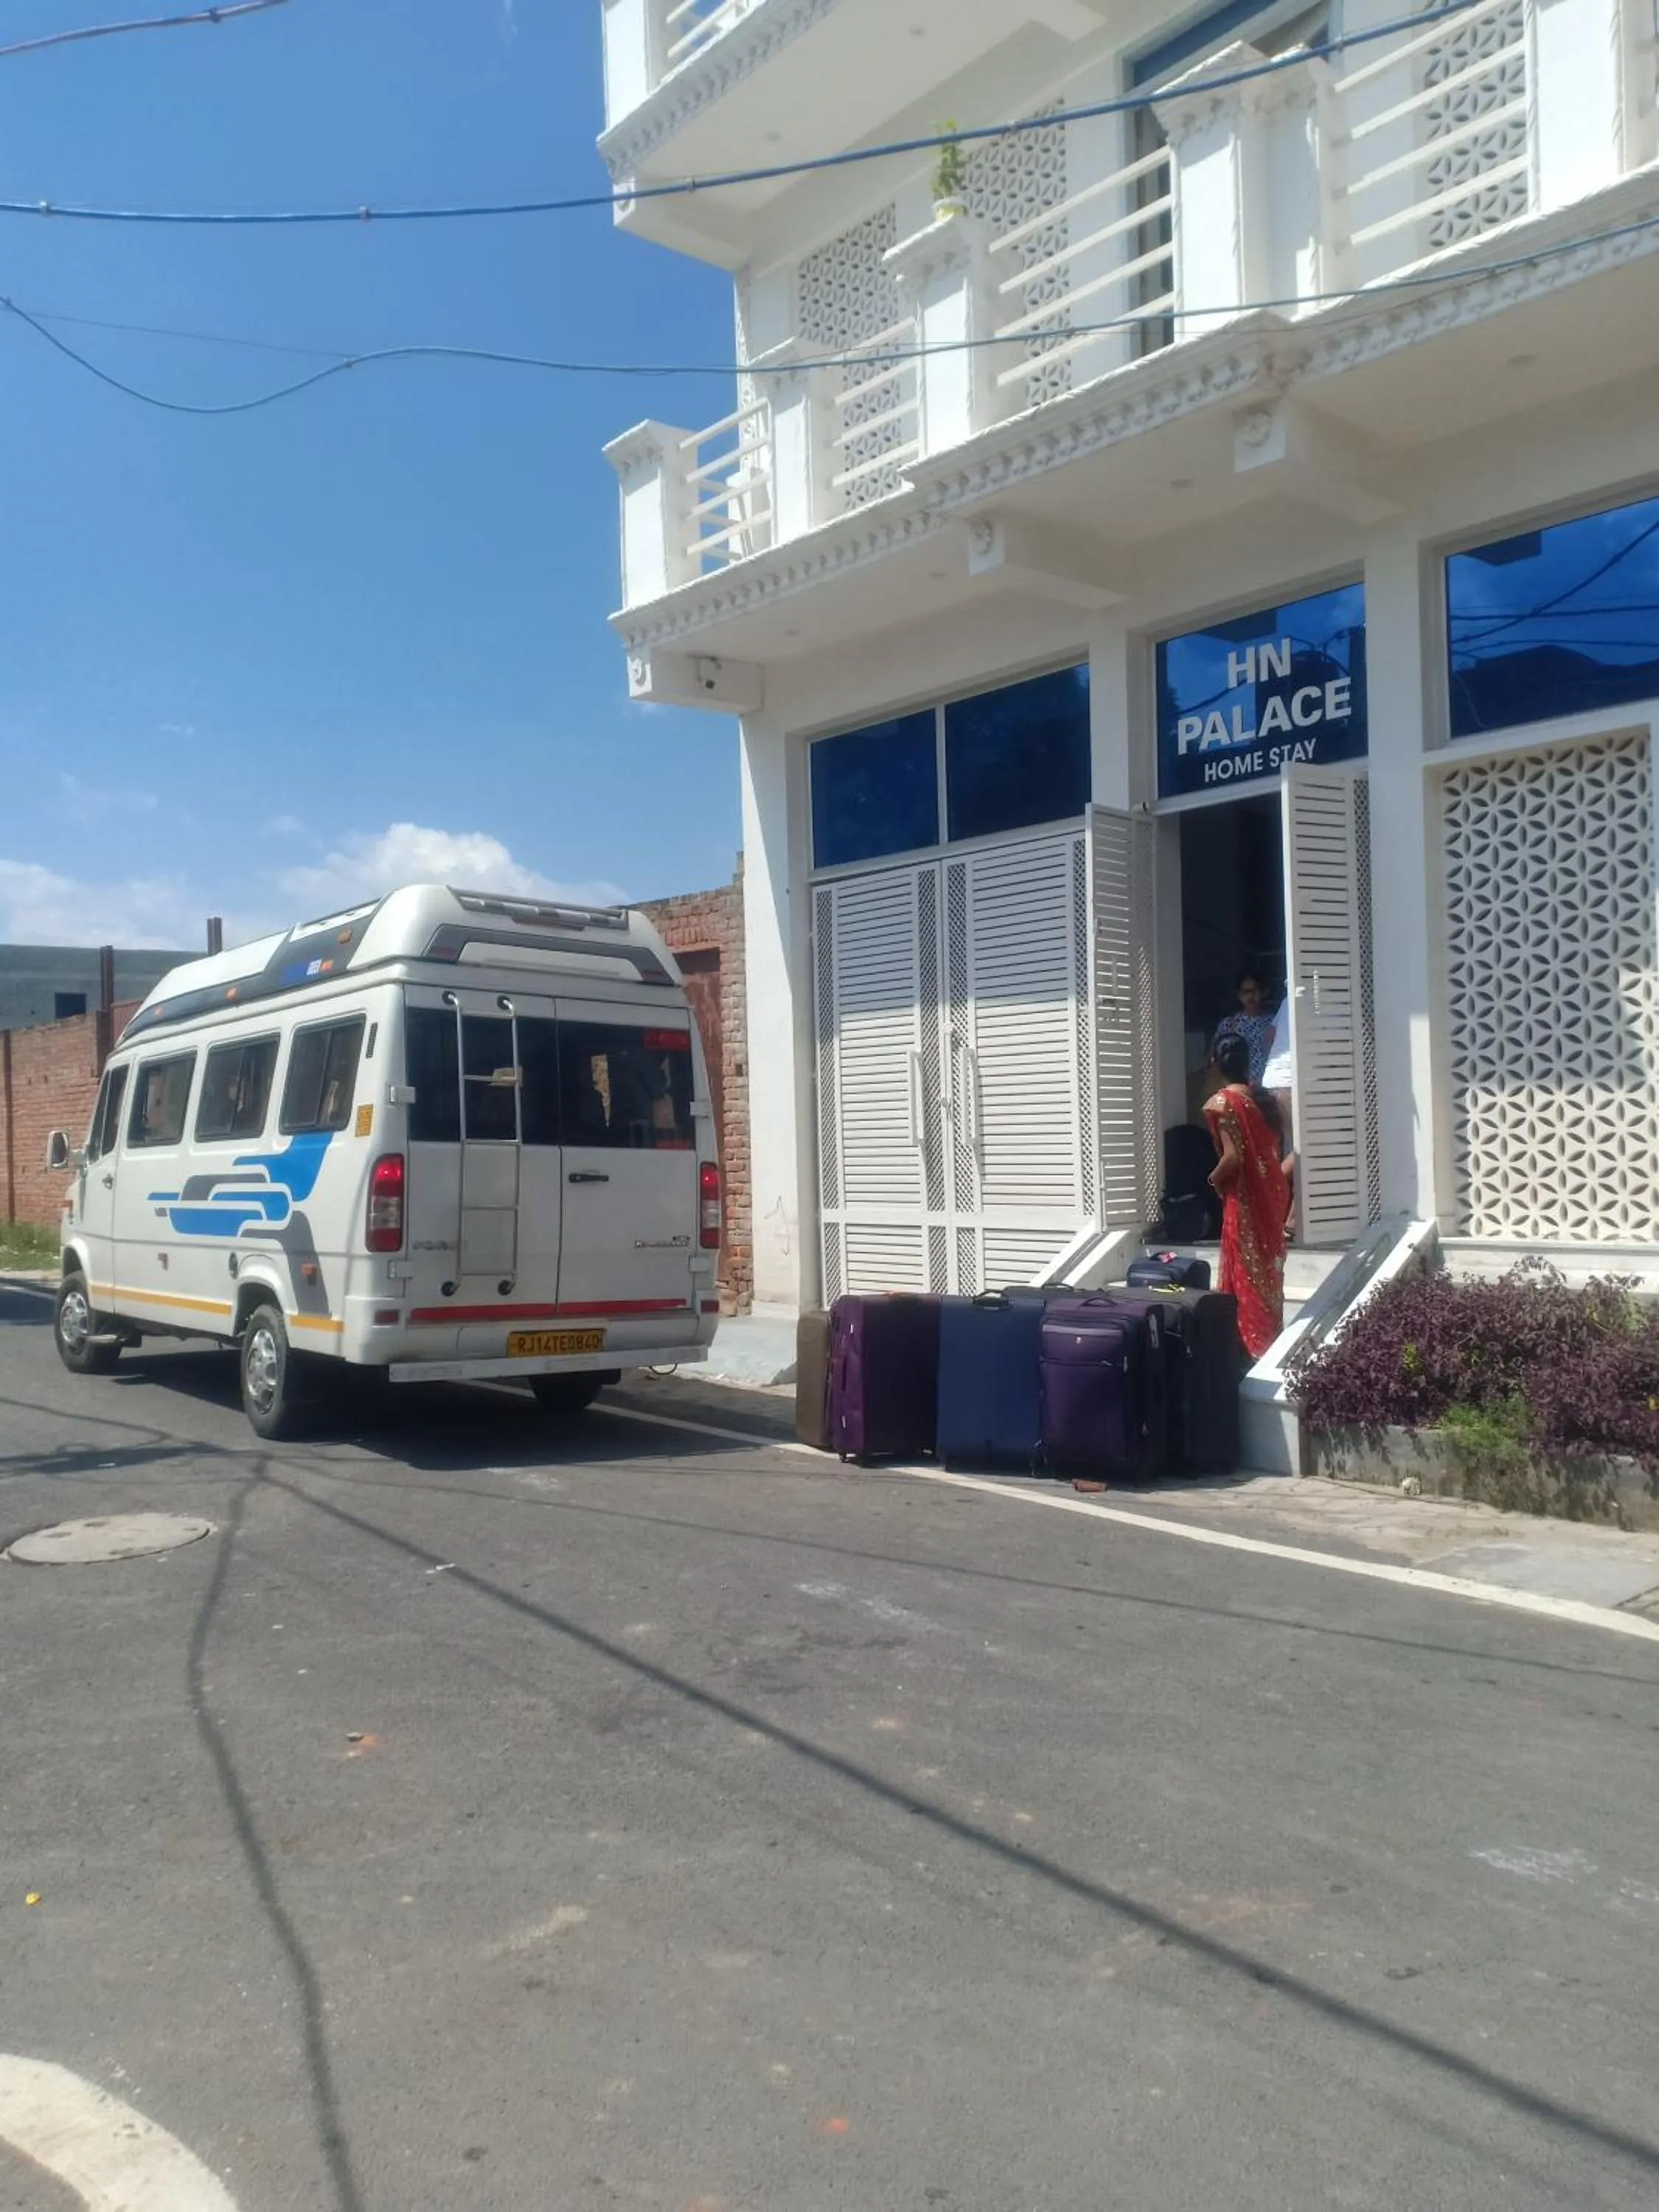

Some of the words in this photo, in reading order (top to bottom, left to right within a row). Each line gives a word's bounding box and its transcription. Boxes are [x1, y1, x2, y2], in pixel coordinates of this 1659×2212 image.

[1228, 637, 1291, 689] HN
[1178, 677, 1352, 756] PALACE
[1204, 751, 1263, 782] HOME
[1269, 738, 1316, 768] STAY
